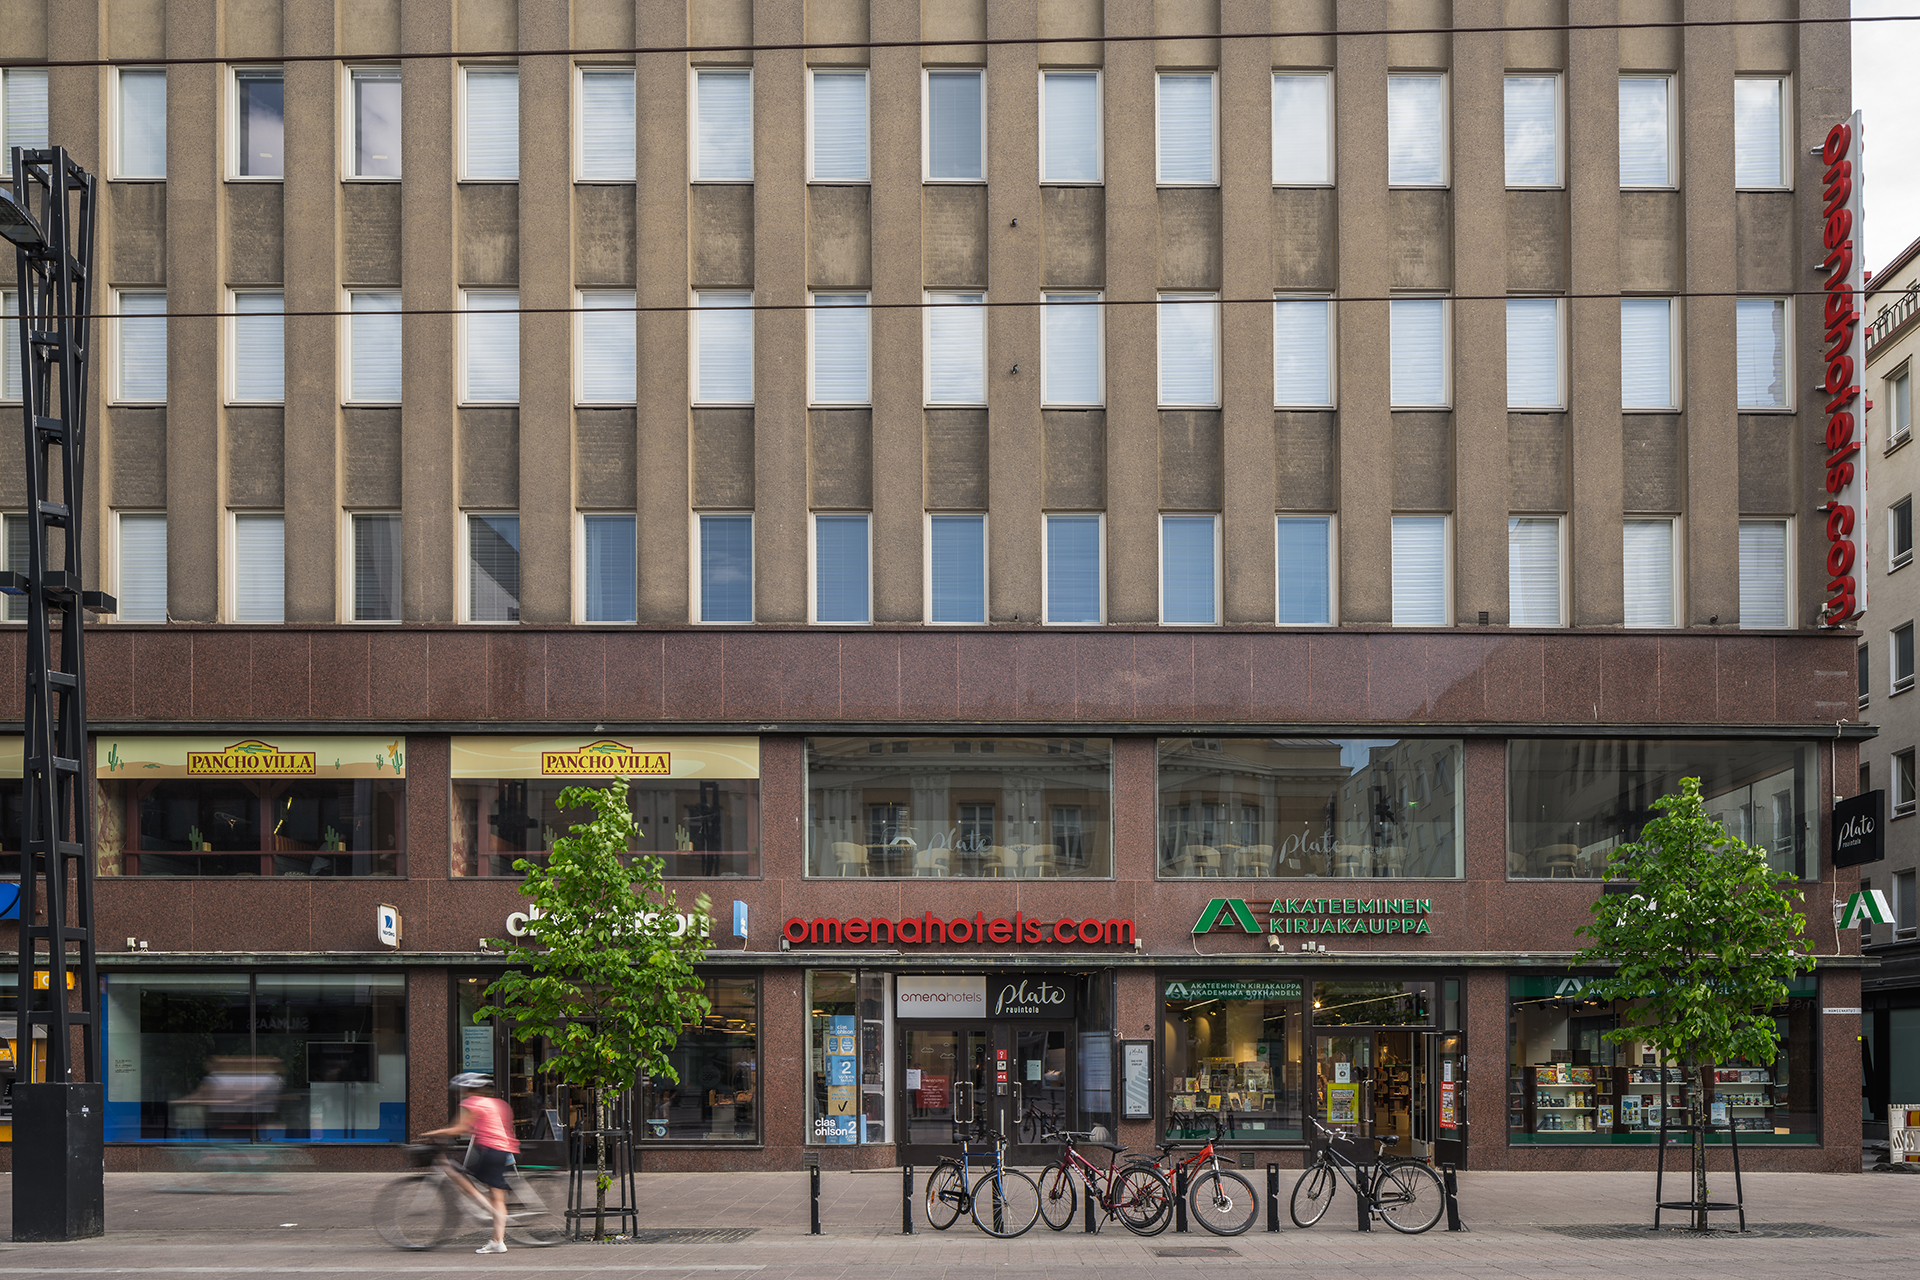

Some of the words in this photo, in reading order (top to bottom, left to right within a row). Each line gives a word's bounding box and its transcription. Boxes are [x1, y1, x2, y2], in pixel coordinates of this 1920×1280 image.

[1822, 123, 1861, 626] omenahotels.com
[192, 755, 259, 769] PANCHO
[262, 755, 312, 769] VILLA
[547, 755, 614, 769] PANCHO
[617, 755, 666, 769] VILLA
[1269, 898, 1431, 914] AKATEEMINEN
[784, 911, 1135, 943] omenahotels.com
[1269, 918, 1431, 933] KIRJAKAUPPA
[901, 992, 982, 1002] omenahotels
[1005, 1006, 1040, 1014] ravintola
[841, 1061, 851, 1074] 2
[814, 1117, 836, 1127] clas
[848, 1121, 857, 1134] 2
[814, 1127, 848, 1136] ohlson
